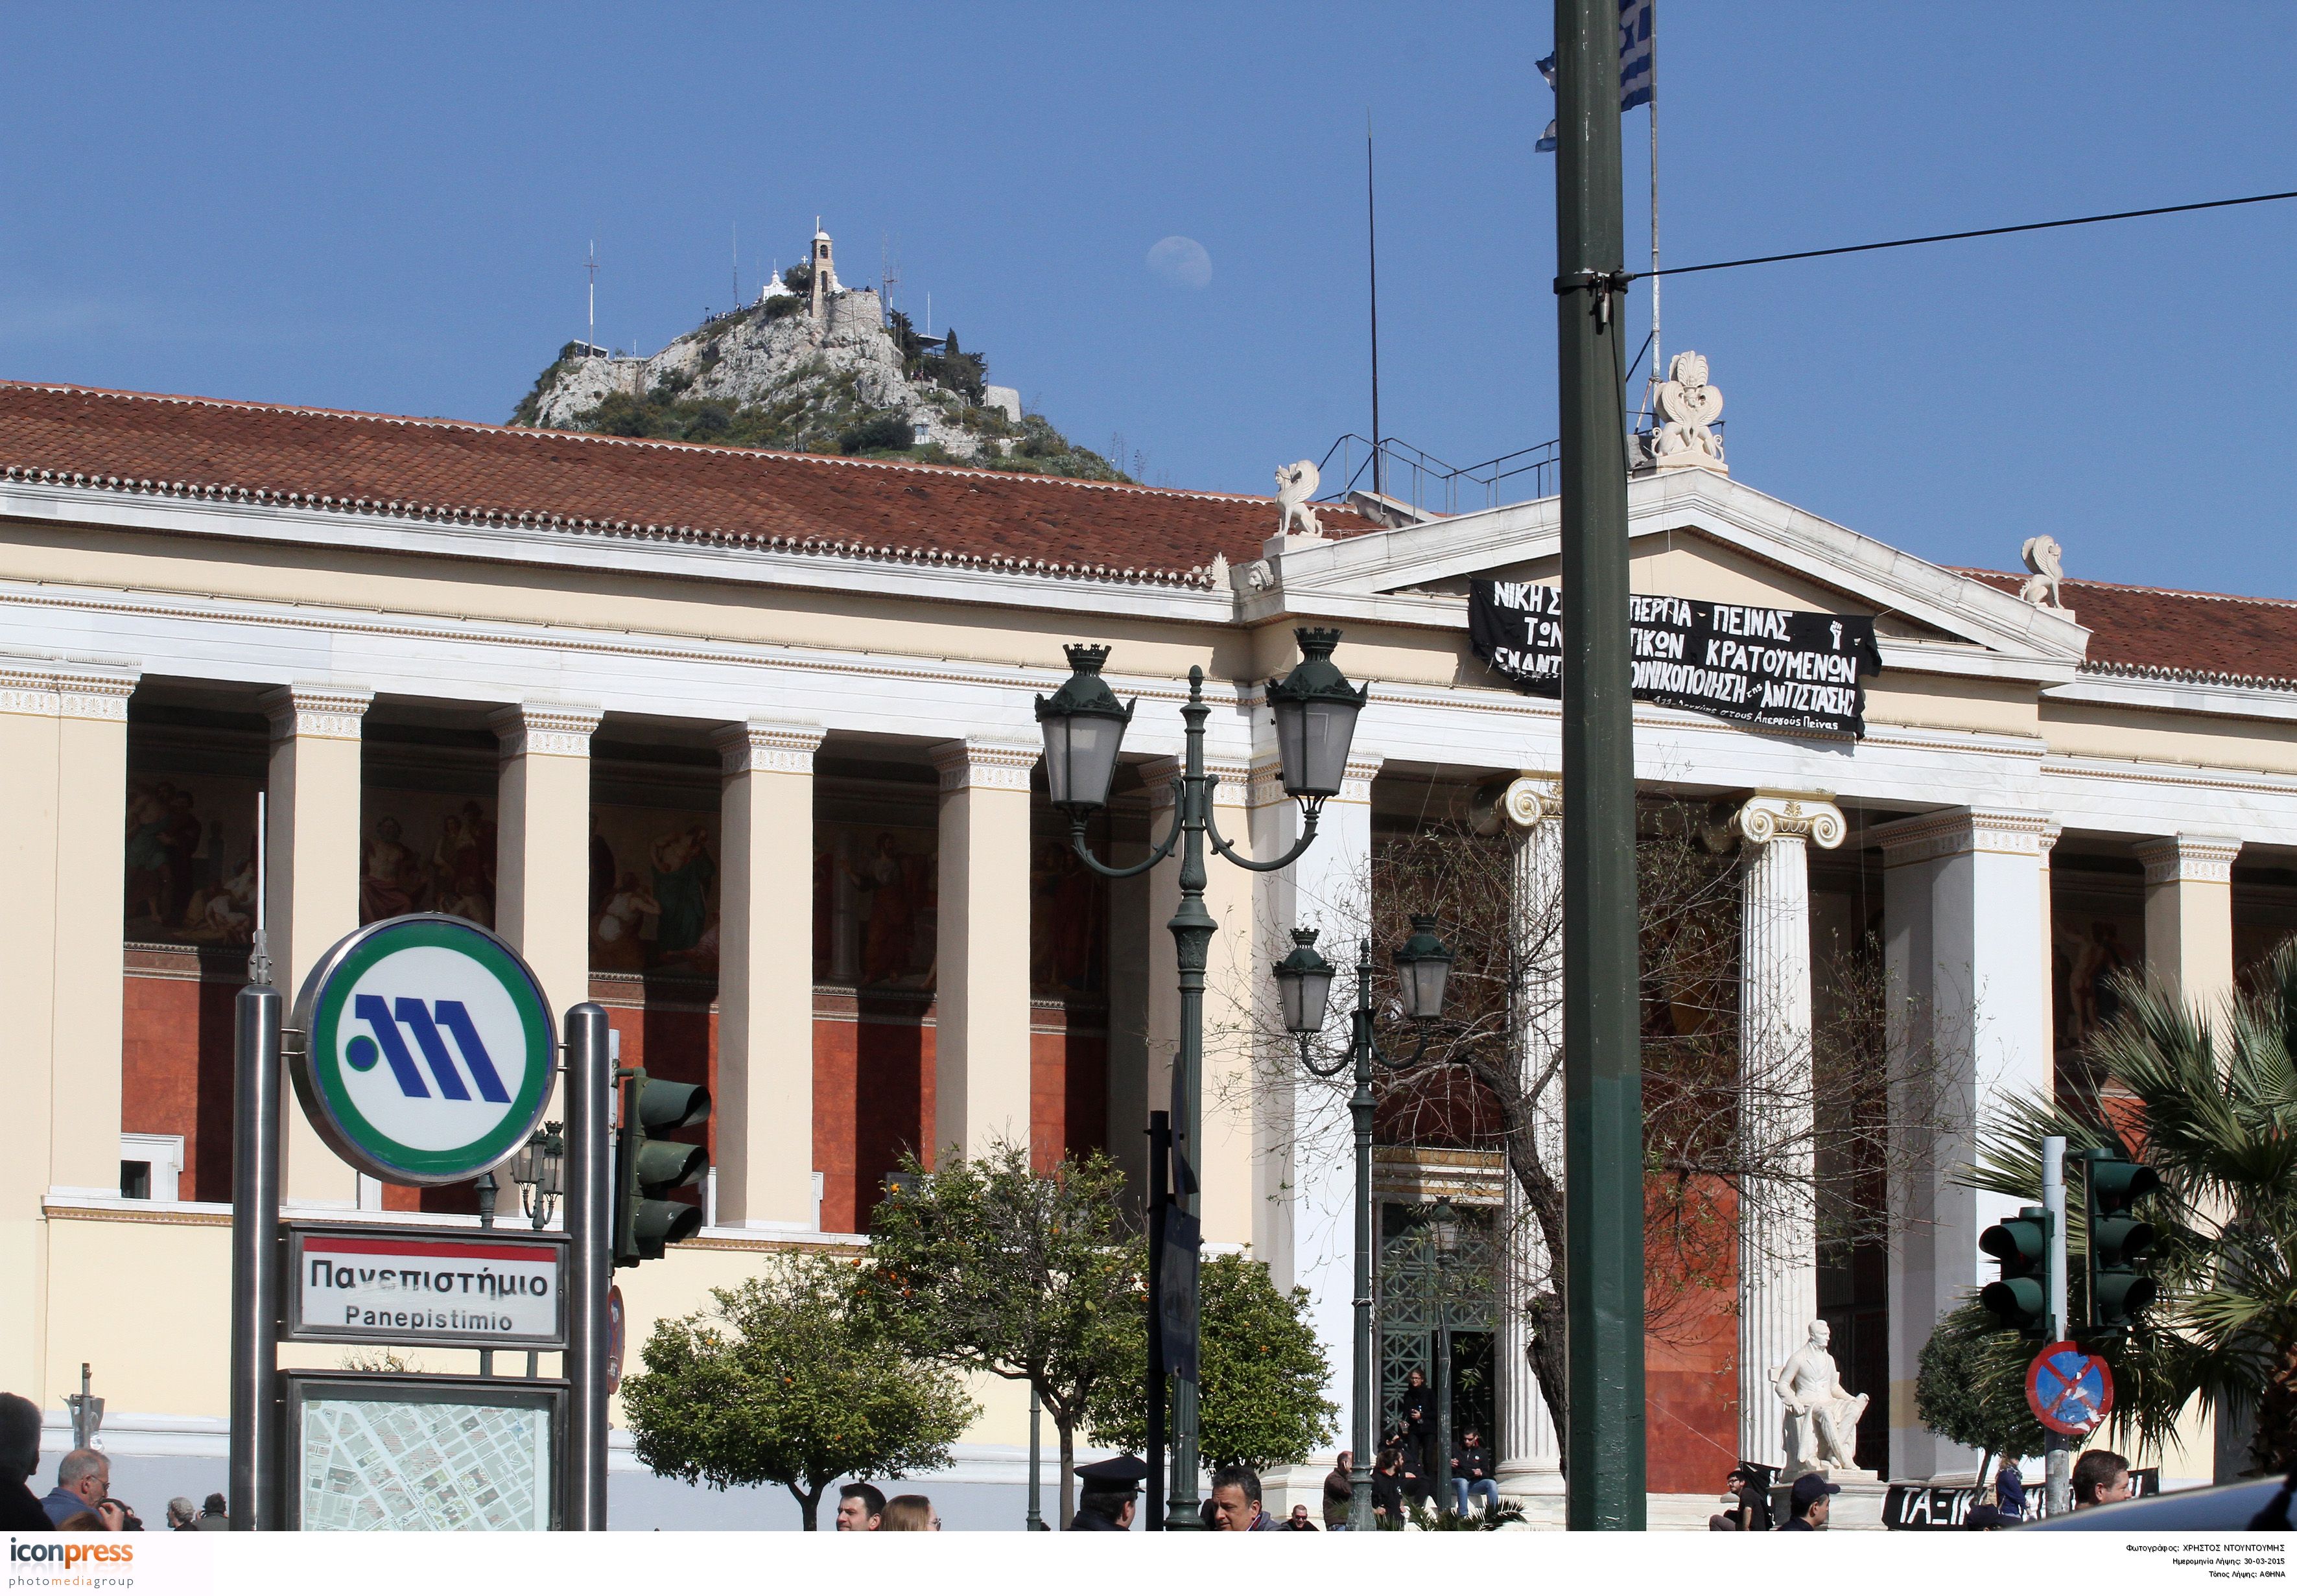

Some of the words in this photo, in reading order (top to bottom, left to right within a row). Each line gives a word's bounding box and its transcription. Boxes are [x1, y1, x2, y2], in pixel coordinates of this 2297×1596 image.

[1494, 581, 1544, 613] ΝΙΚΗ
[1630, 596, 1692, 628] ΠΕΡΓΙΑ
[1713, 605, 1793, 642] ΠΕΙΝΑΣ
[1631, 660, 1747, 704] ΟΙΝΙΚΟΠΟΙΗΣΗ
[1705, 639, 1857, 685] ΚΡΑΤΟΥΜΕΝΩΝ
[1719, 709, 1752, 721] στους
[1754, 710, 1801, 727] Απεργούς
[1802, 715, 1839, 731] Πείνας
[311, 1259, 548, 1300] Πανεπιστήμιο
[346, 1305, 513, 1330] Panepistimio
[1900, 1486, 1986, 1525] ΤΑΞΙΚ
